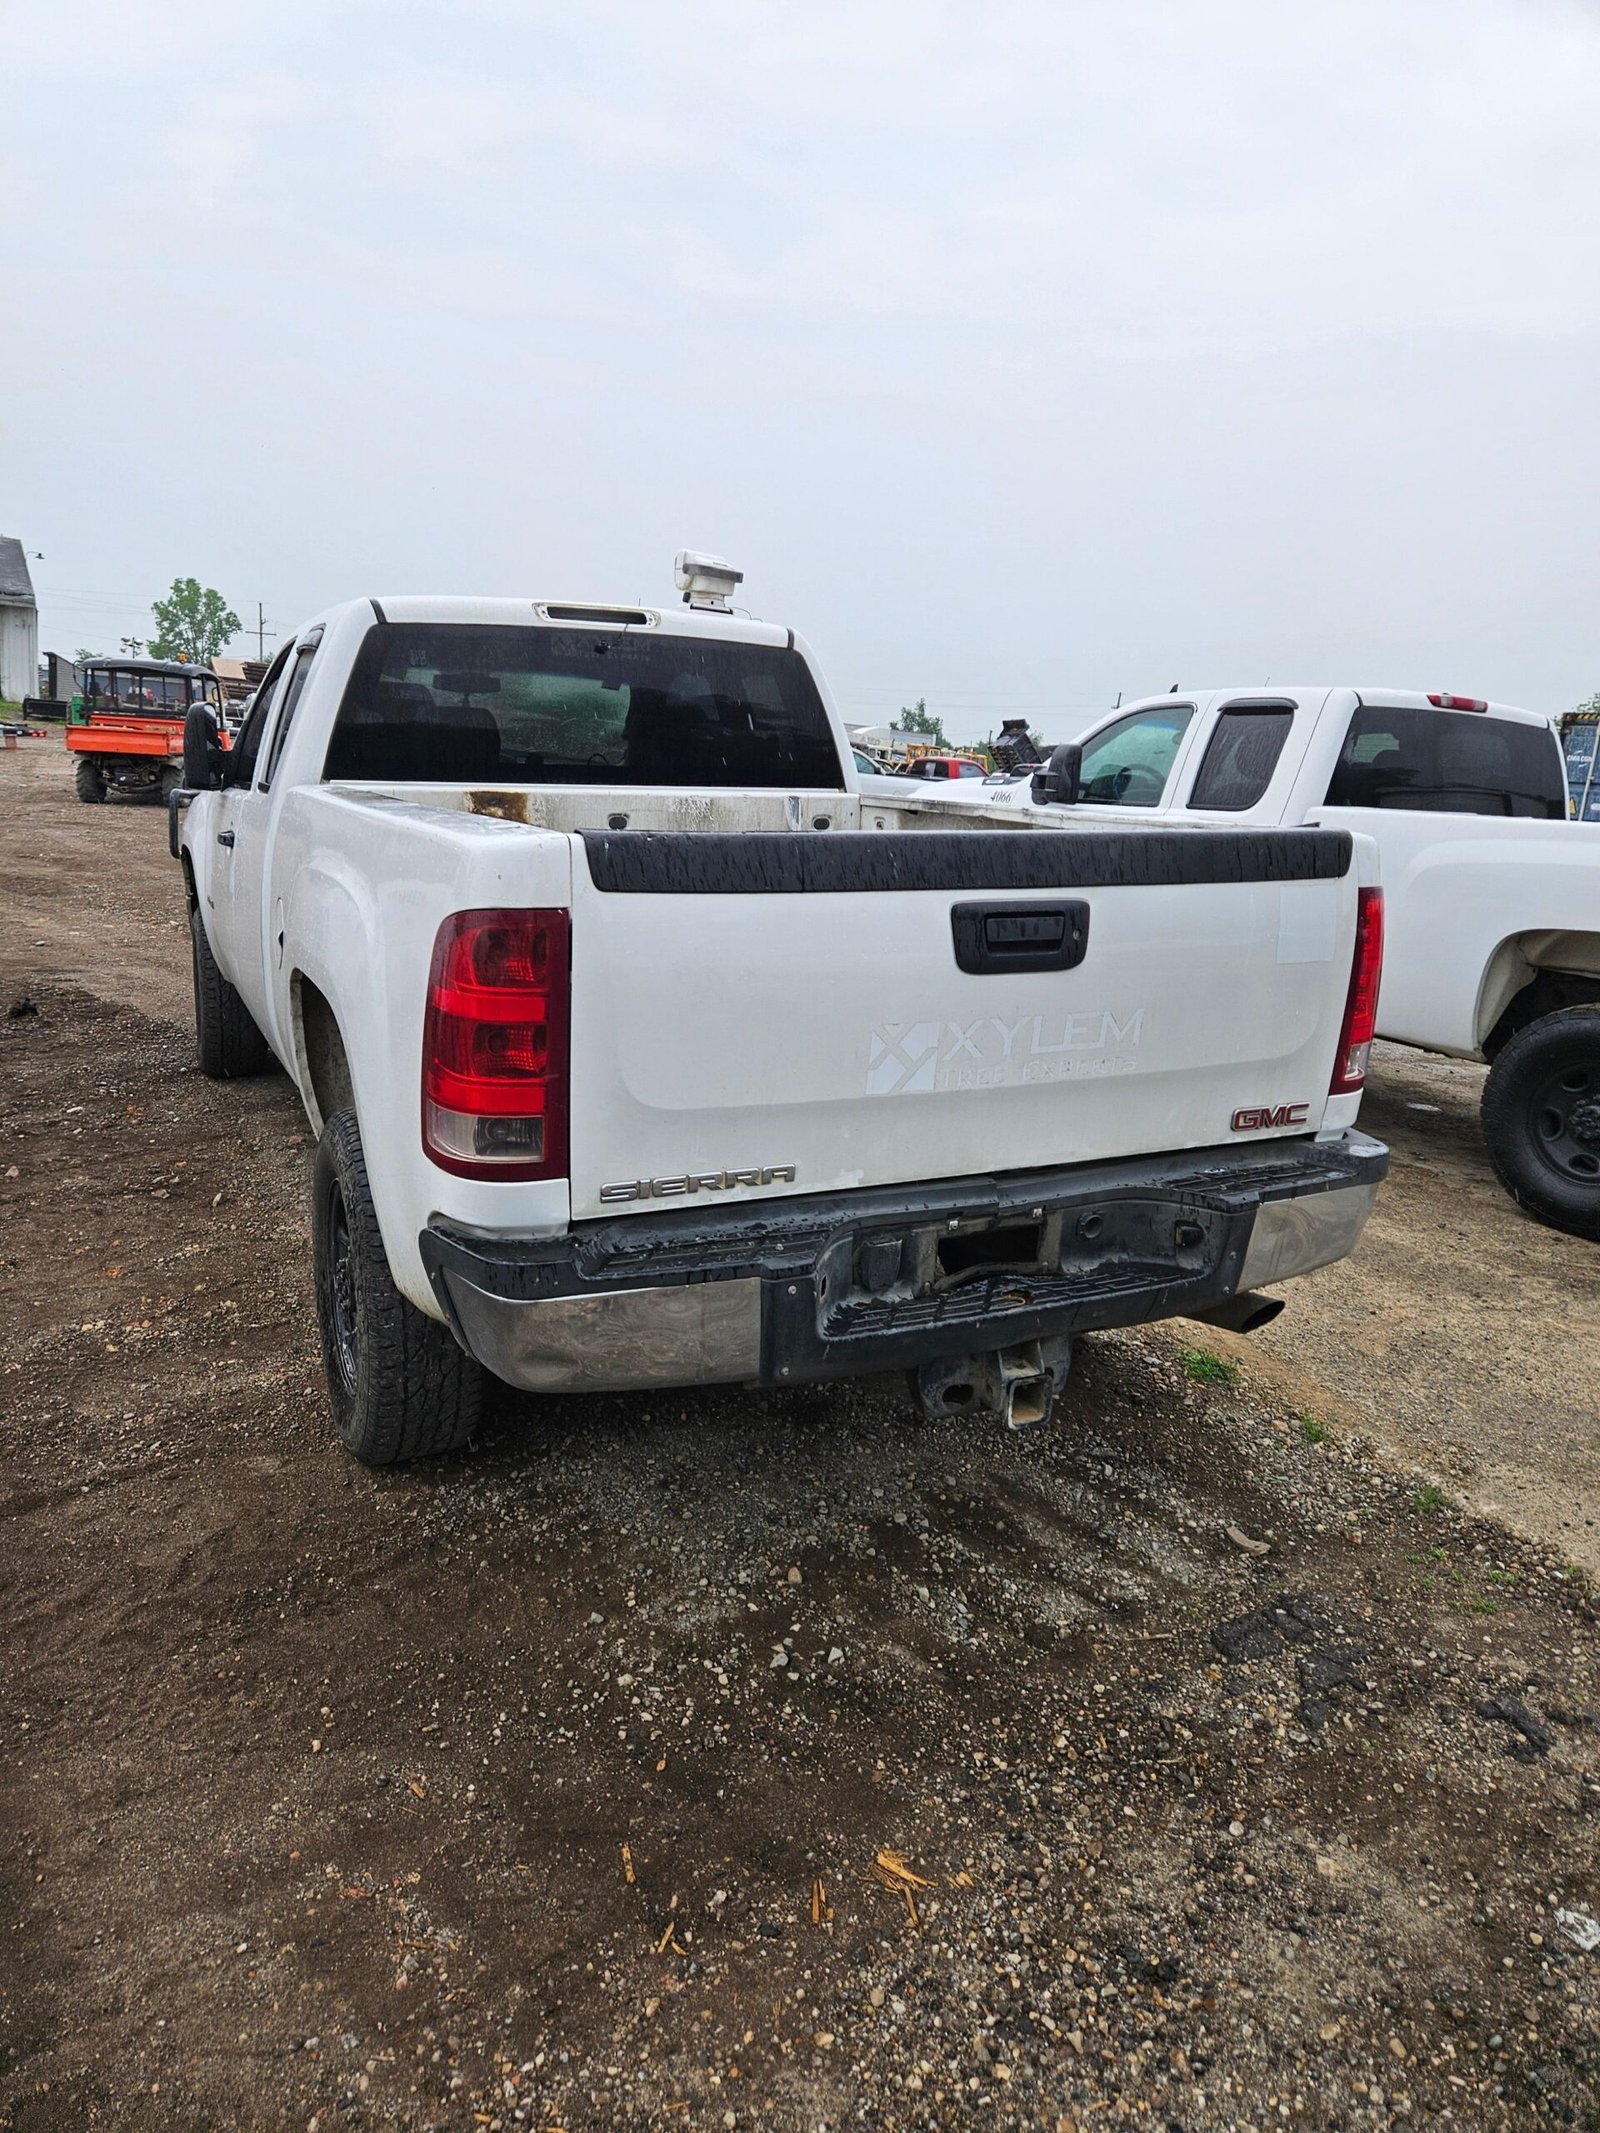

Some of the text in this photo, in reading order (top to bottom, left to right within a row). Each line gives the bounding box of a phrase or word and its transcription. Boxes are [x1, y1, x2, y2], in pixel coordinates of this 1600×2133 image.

[942, 1008, 1146, 1062] XYLEM
[940, 1055, 1138, 1088] TREE EXPERTS
[1230, 1102, 1311, 1132] GMC
[599, 1162, 797, 1204] SIERRA
